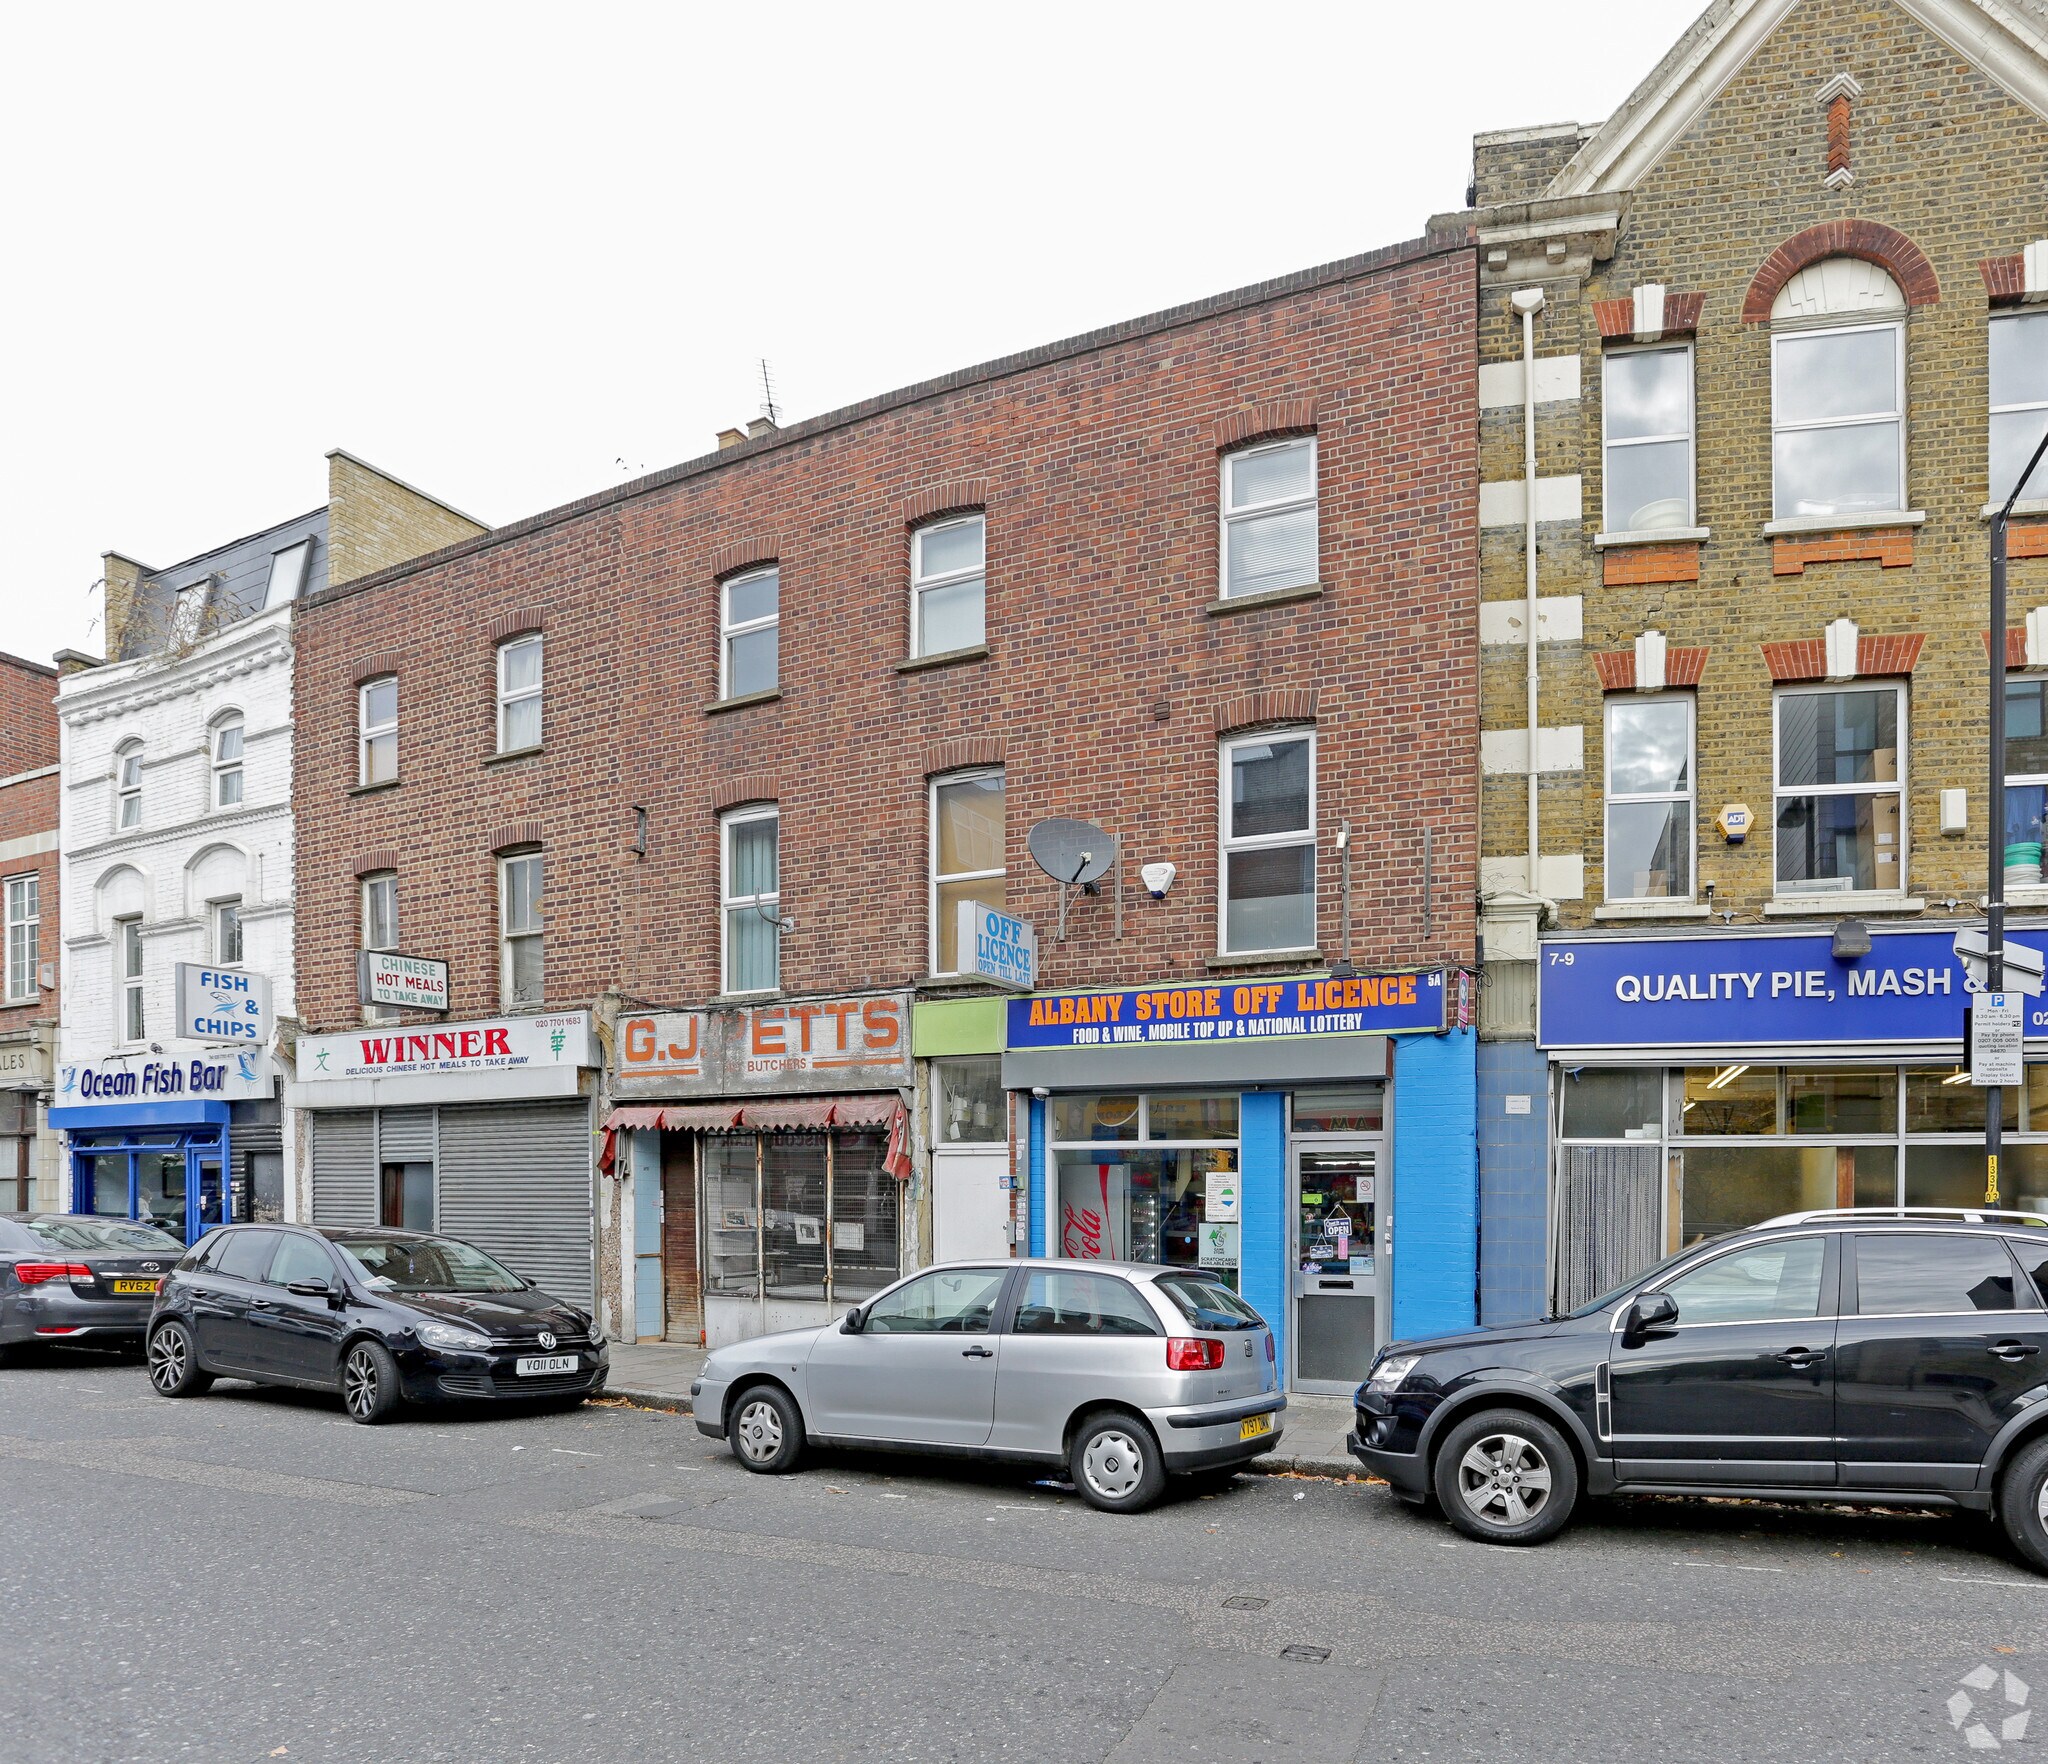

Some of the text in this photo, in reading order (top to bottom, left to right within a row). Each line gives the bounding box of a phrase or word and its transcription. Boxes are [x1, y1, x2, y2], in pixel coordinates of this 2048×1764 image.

[1728, 815, 1744, 823] ADT
[987, 913, 1022, 944] OFF
[978, 934, 1031, 971] LICENCE
[1549, 952, 1575, 967] 7-9
[382, 957, 436, 977] CHINESE
[978, 960, 1031, 985] OPEN TILL LATE
[201, 971, 248, 993] FISH
[376, 972, 444, 993] HOT MEALS
[1428, 974, 1441, 987] 5A
[1615, 972, 1762, 1002] QUALITY
[1771, 970, 1836, 1002] PIE,
[1847, 967, 1951, 997] MASH
[377, 988, 444, 1006] TO TAKE AWAY
[1029, 975, 1417, 1026] ALBANY STORE OFF LICENCE
[245, 999, 259, 1016] &
[194, 1017, 257, 1039] CHIPS
[536, 1020, 548, 1028] 020
[1073, 1012, 1363, 1044] FOOD & WINE, MOBILE TOP UP & NATIONAL LOTTERY
[360, 1027, 513, 1064] WINNER
[0, 1054, 25, 1070] LES
[314, 1048, 330, 1072] 文
[346, 1056, 530, 1075] DELICIOUS CHINESE HOT MEALS TO TAKE AWAY
[748, 1058, 807, 1072] BUTCHERS
[81, 1059, 226, 1098] Ocean Fish Bar
[1328, 1226, 1349, 1235] OPEN
[120, 1282, 150, 1291] RV62
